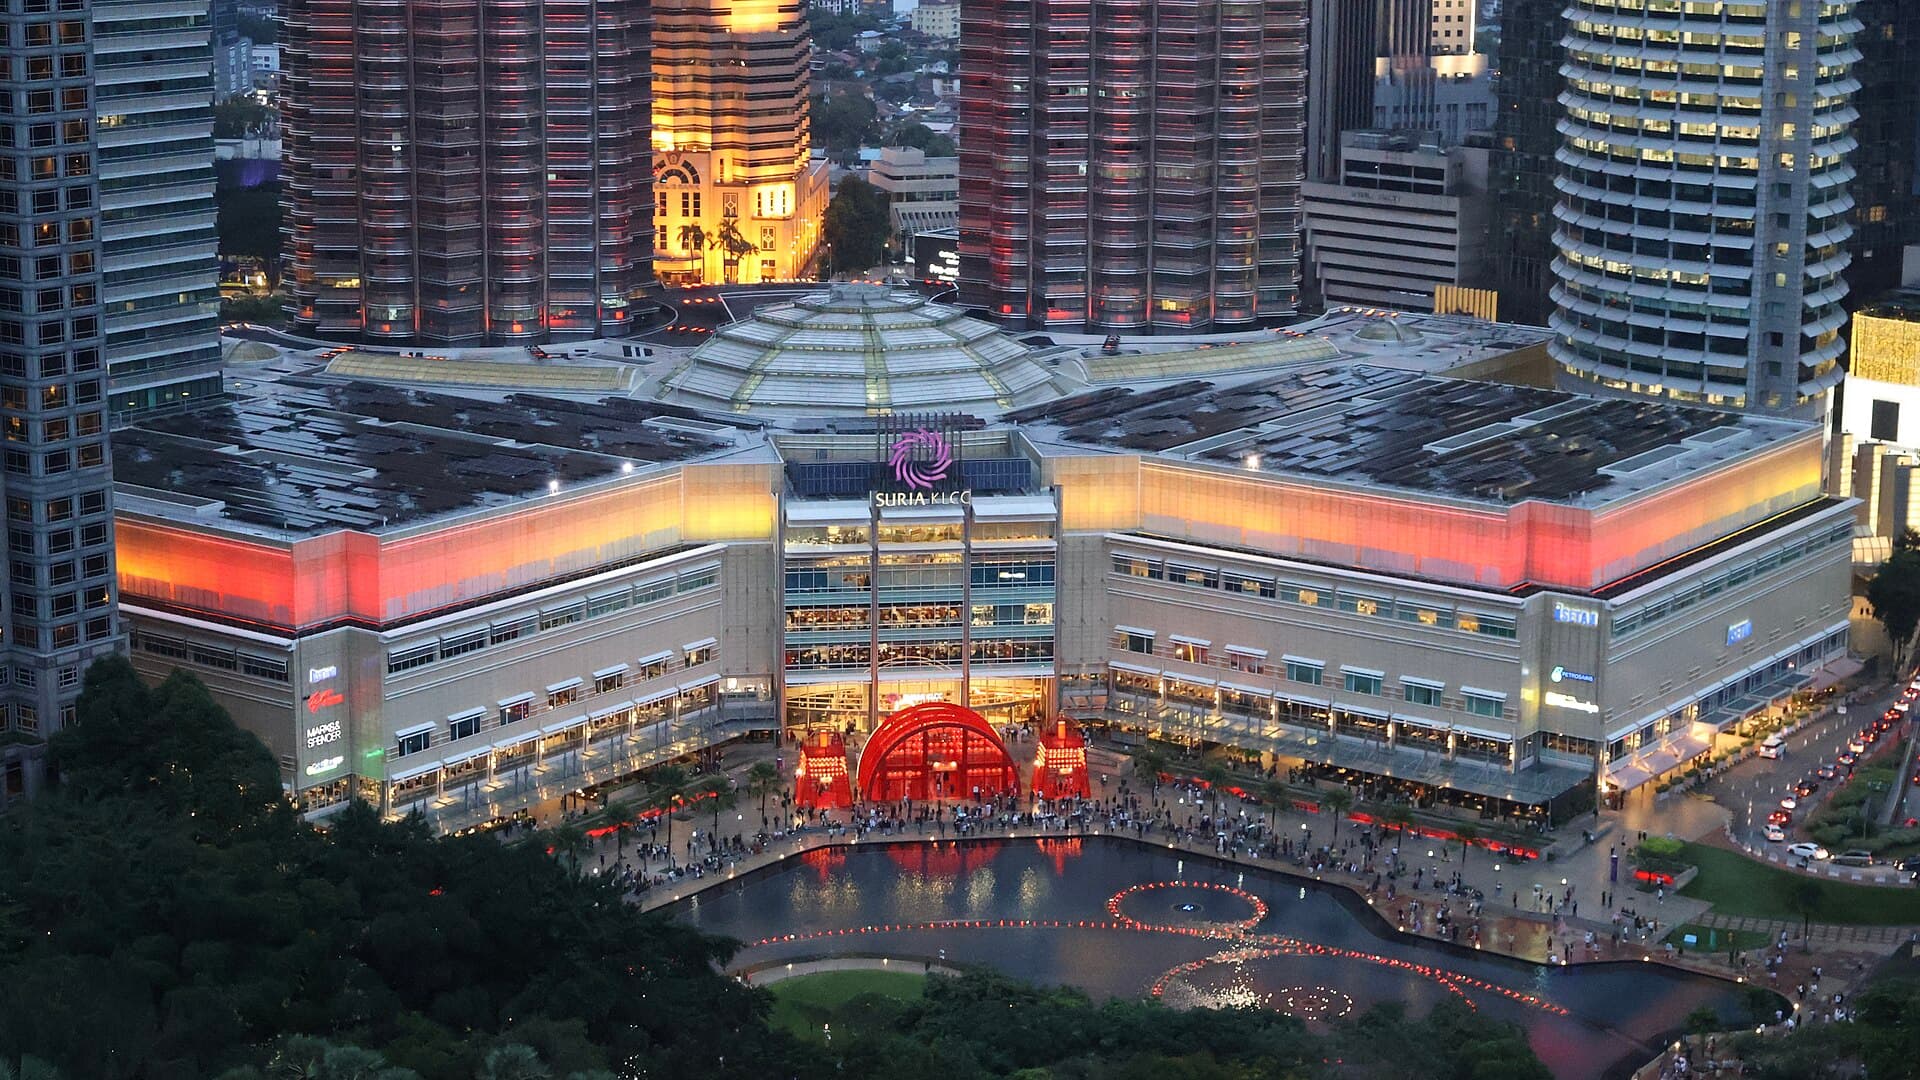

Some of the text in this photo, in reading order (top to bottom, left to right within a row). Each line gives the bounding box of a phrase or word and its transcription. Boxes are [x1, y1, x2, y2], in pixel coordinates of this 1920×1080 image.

[875, 490, 971, 507] SURIA KLCC
[307, 730, 342, 748] SPENCER
